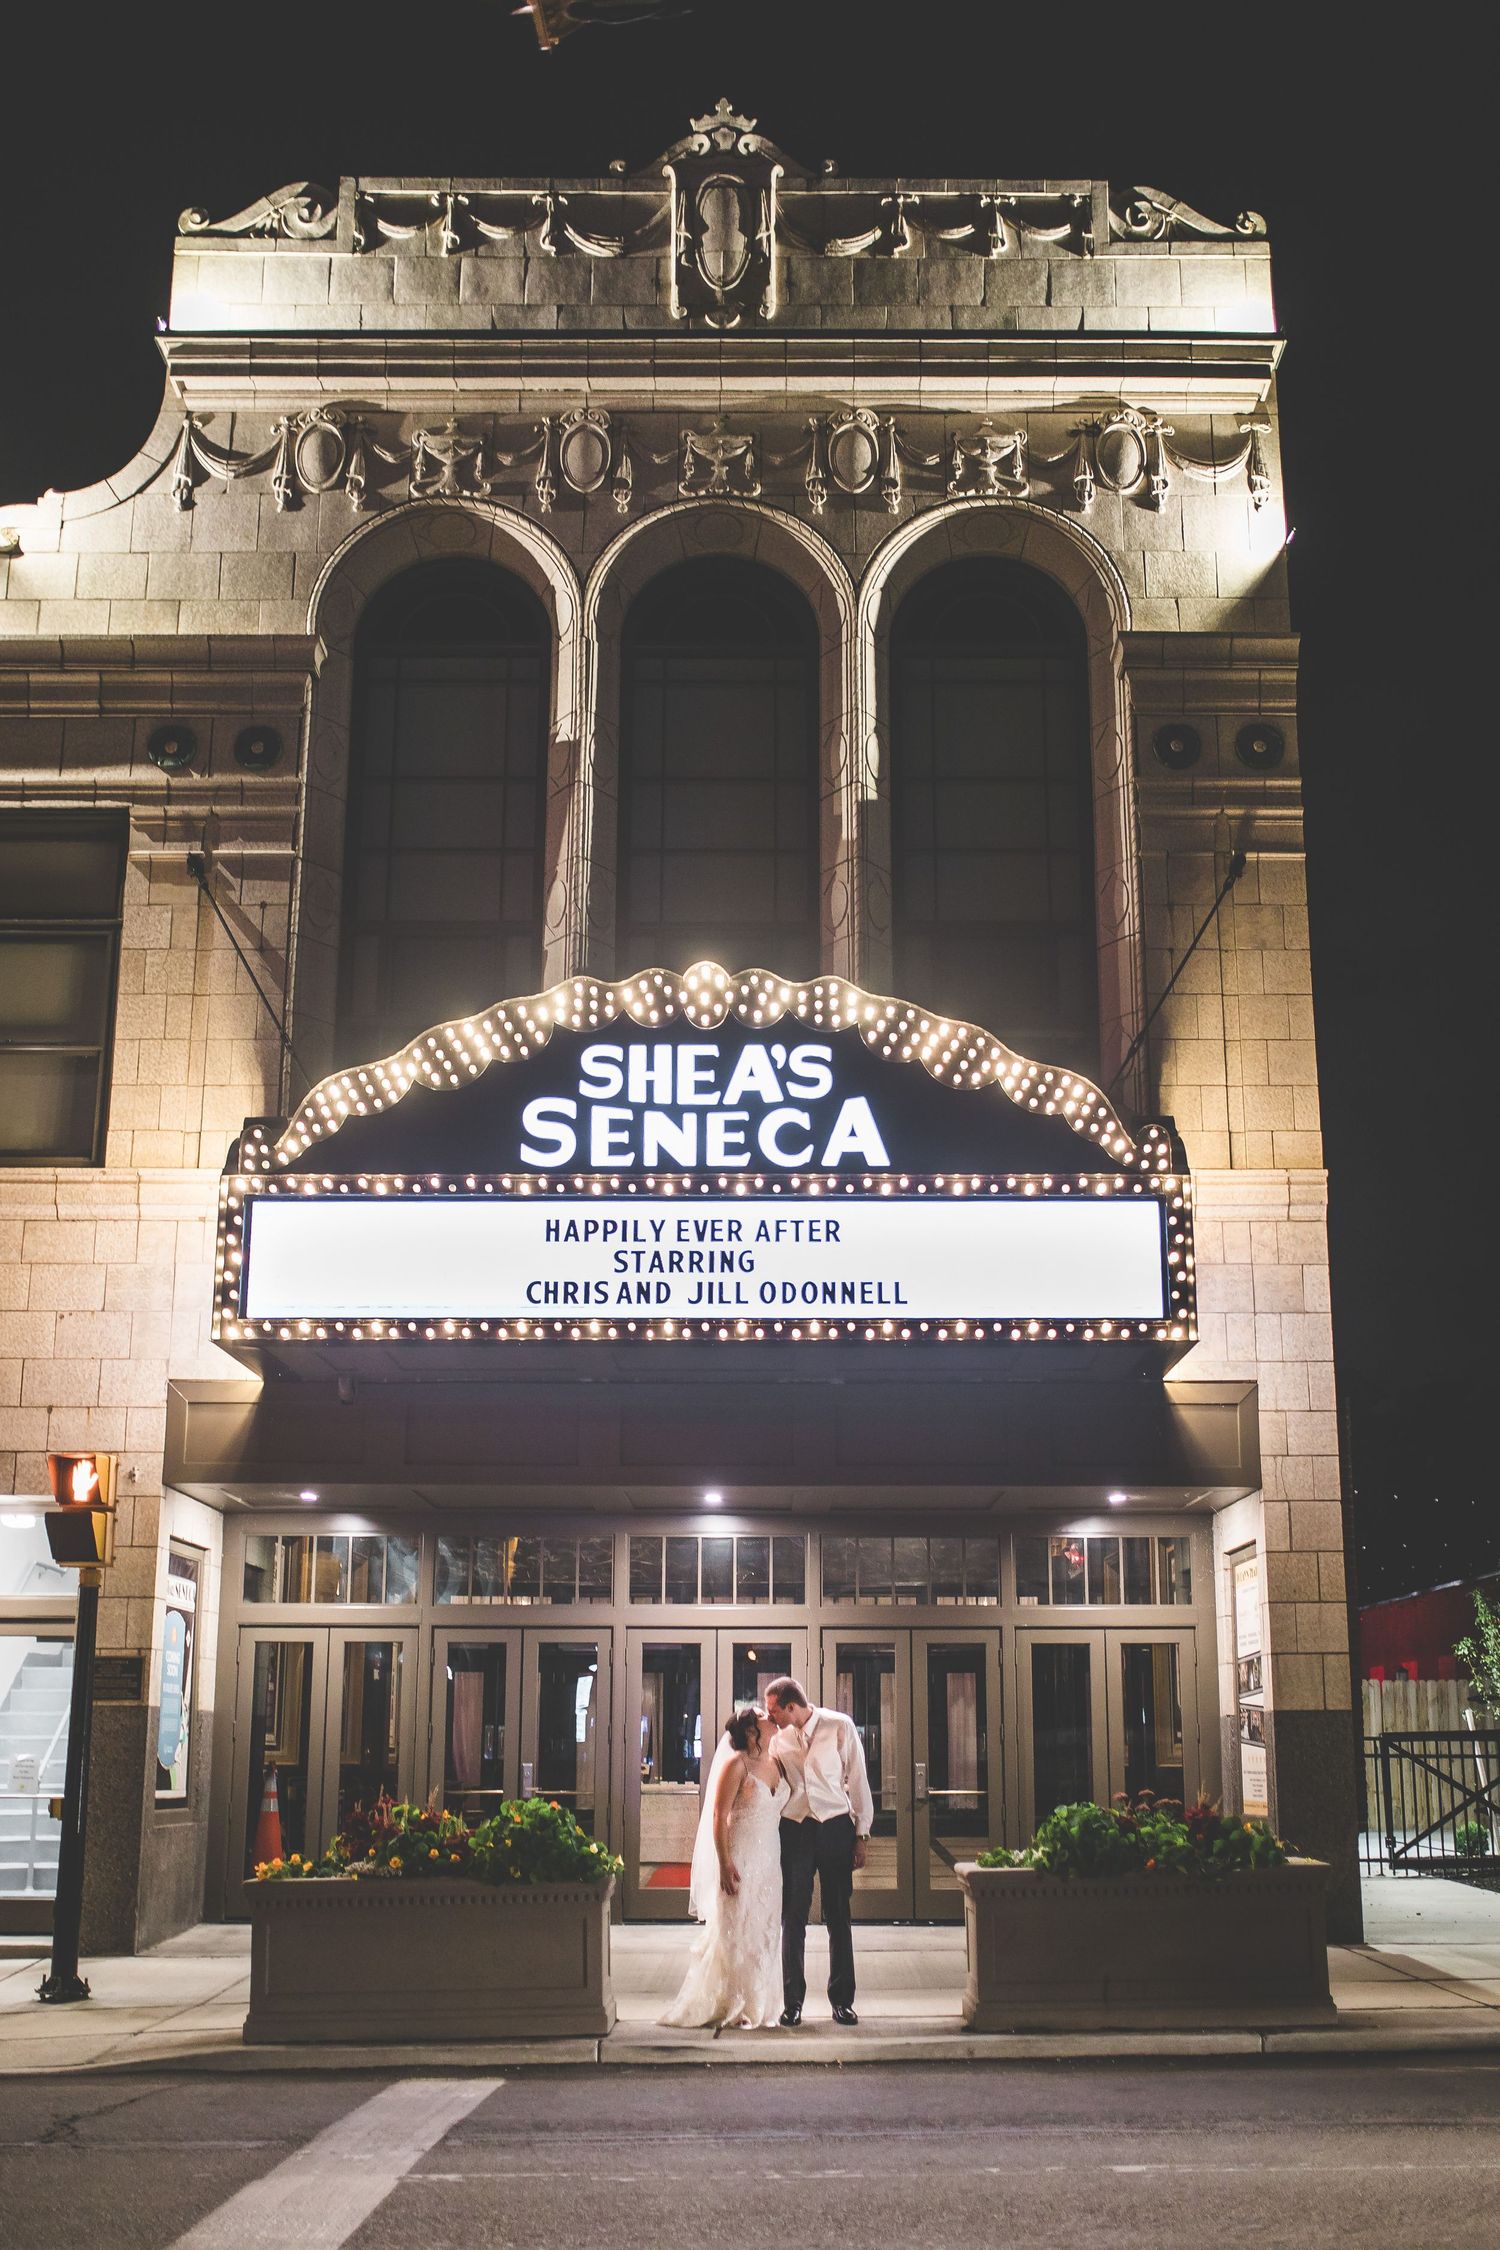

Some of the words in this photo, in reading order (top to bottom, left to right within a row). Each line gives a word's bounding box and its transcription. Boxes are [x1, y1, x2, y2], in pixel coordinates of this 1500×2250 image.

[578, 1044, 833, 1105] SHEA'S
[520, 1097, 891, 1167] SENECA
[546, 1220, 666, 1242] HAPPILY
[677, 1220, 743, 1242] EVER
[755, 1220, 841, 1242] AFTER
[614, 1250, 755, 1273] STARRING
[525, 1281, 609, 1304] CHRIS
[616, 1281, 672, 1304] AND
[688, 1281, 749, 1304] JILL
[760, 1281, 908, 1304] ODONNELL
